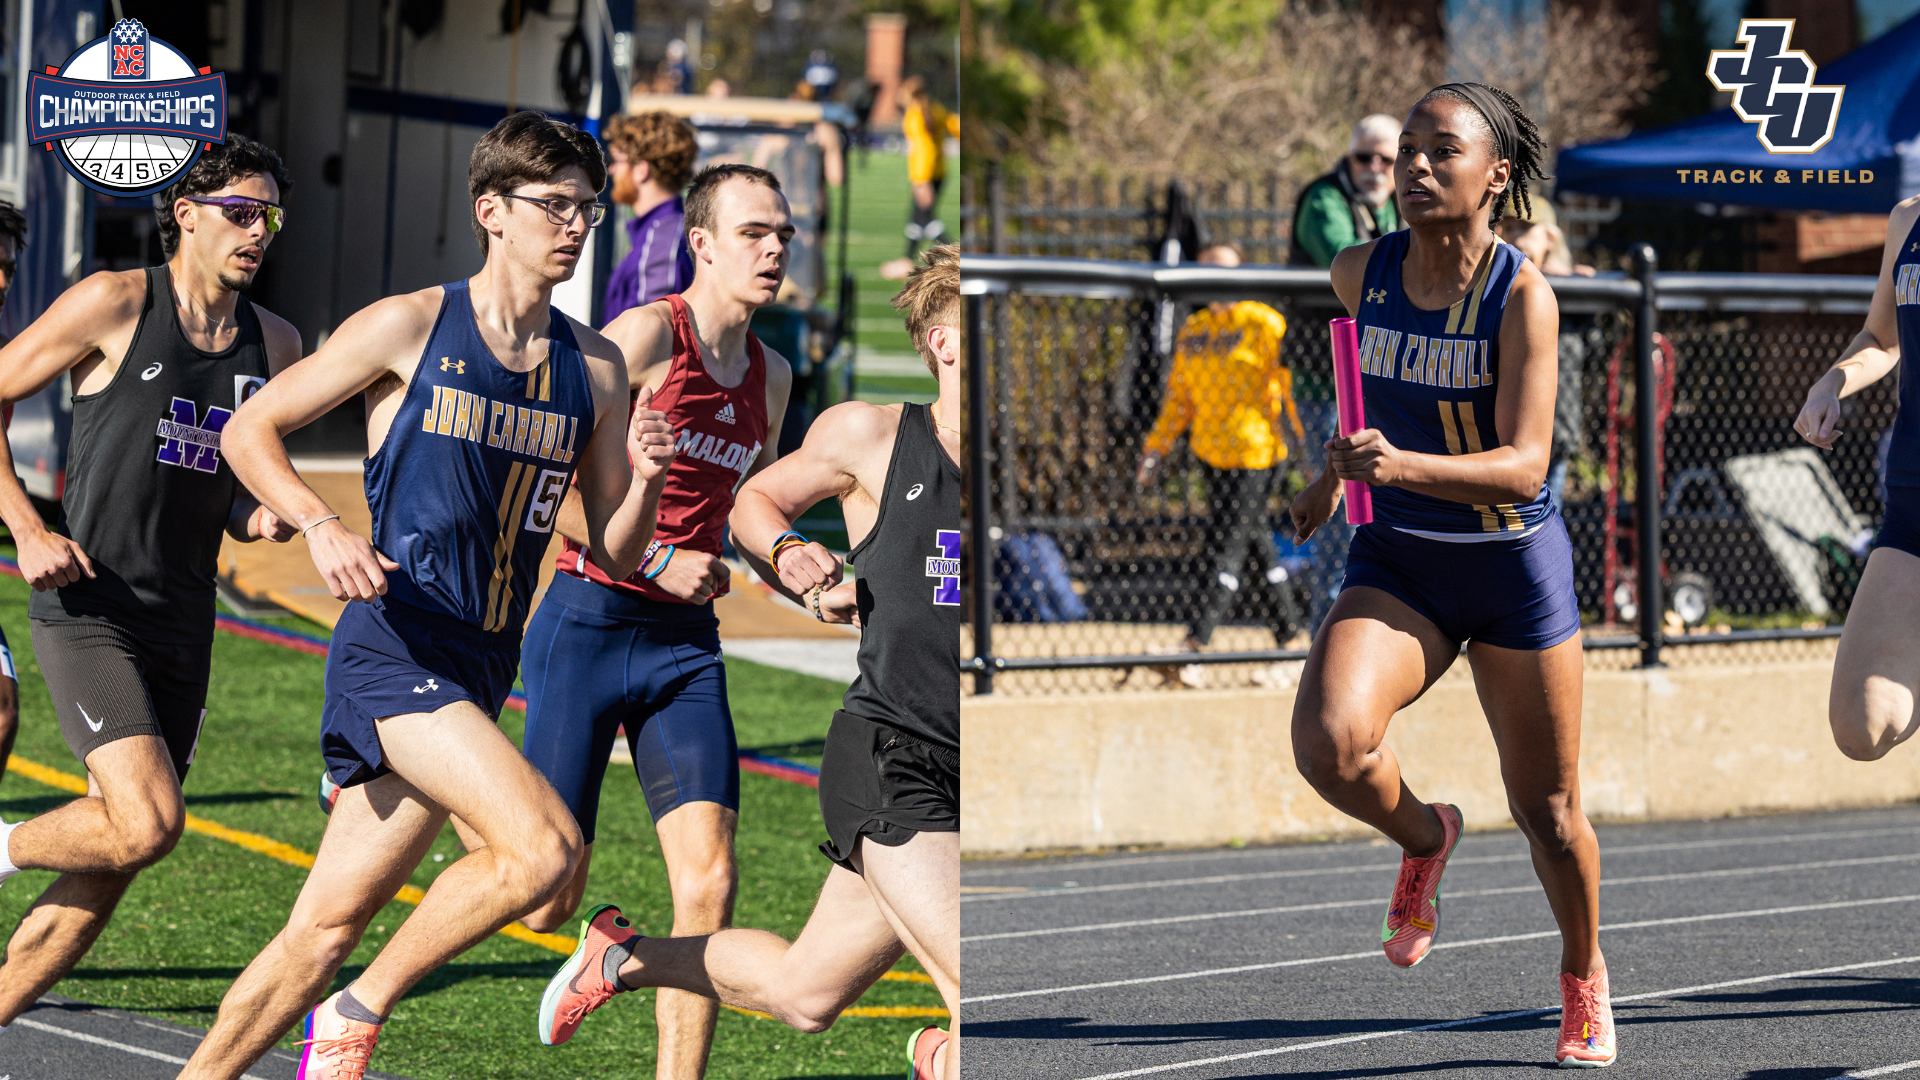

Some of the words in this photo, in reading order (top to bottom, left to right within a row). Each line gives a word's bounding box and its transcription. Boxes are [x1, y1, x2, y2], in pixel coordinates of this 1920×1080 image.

[1896, 264, 1920, 306] JOH
[1400, 333, 1494, 389] CARROLL
[422, 384, 487, 444] JOHN
[486, 399, 579, 464] CARROLL
[714, 413, 737, 425] adidas
[675, 428, 754, 474] MALON
[532, 474, 565, 529] 5
